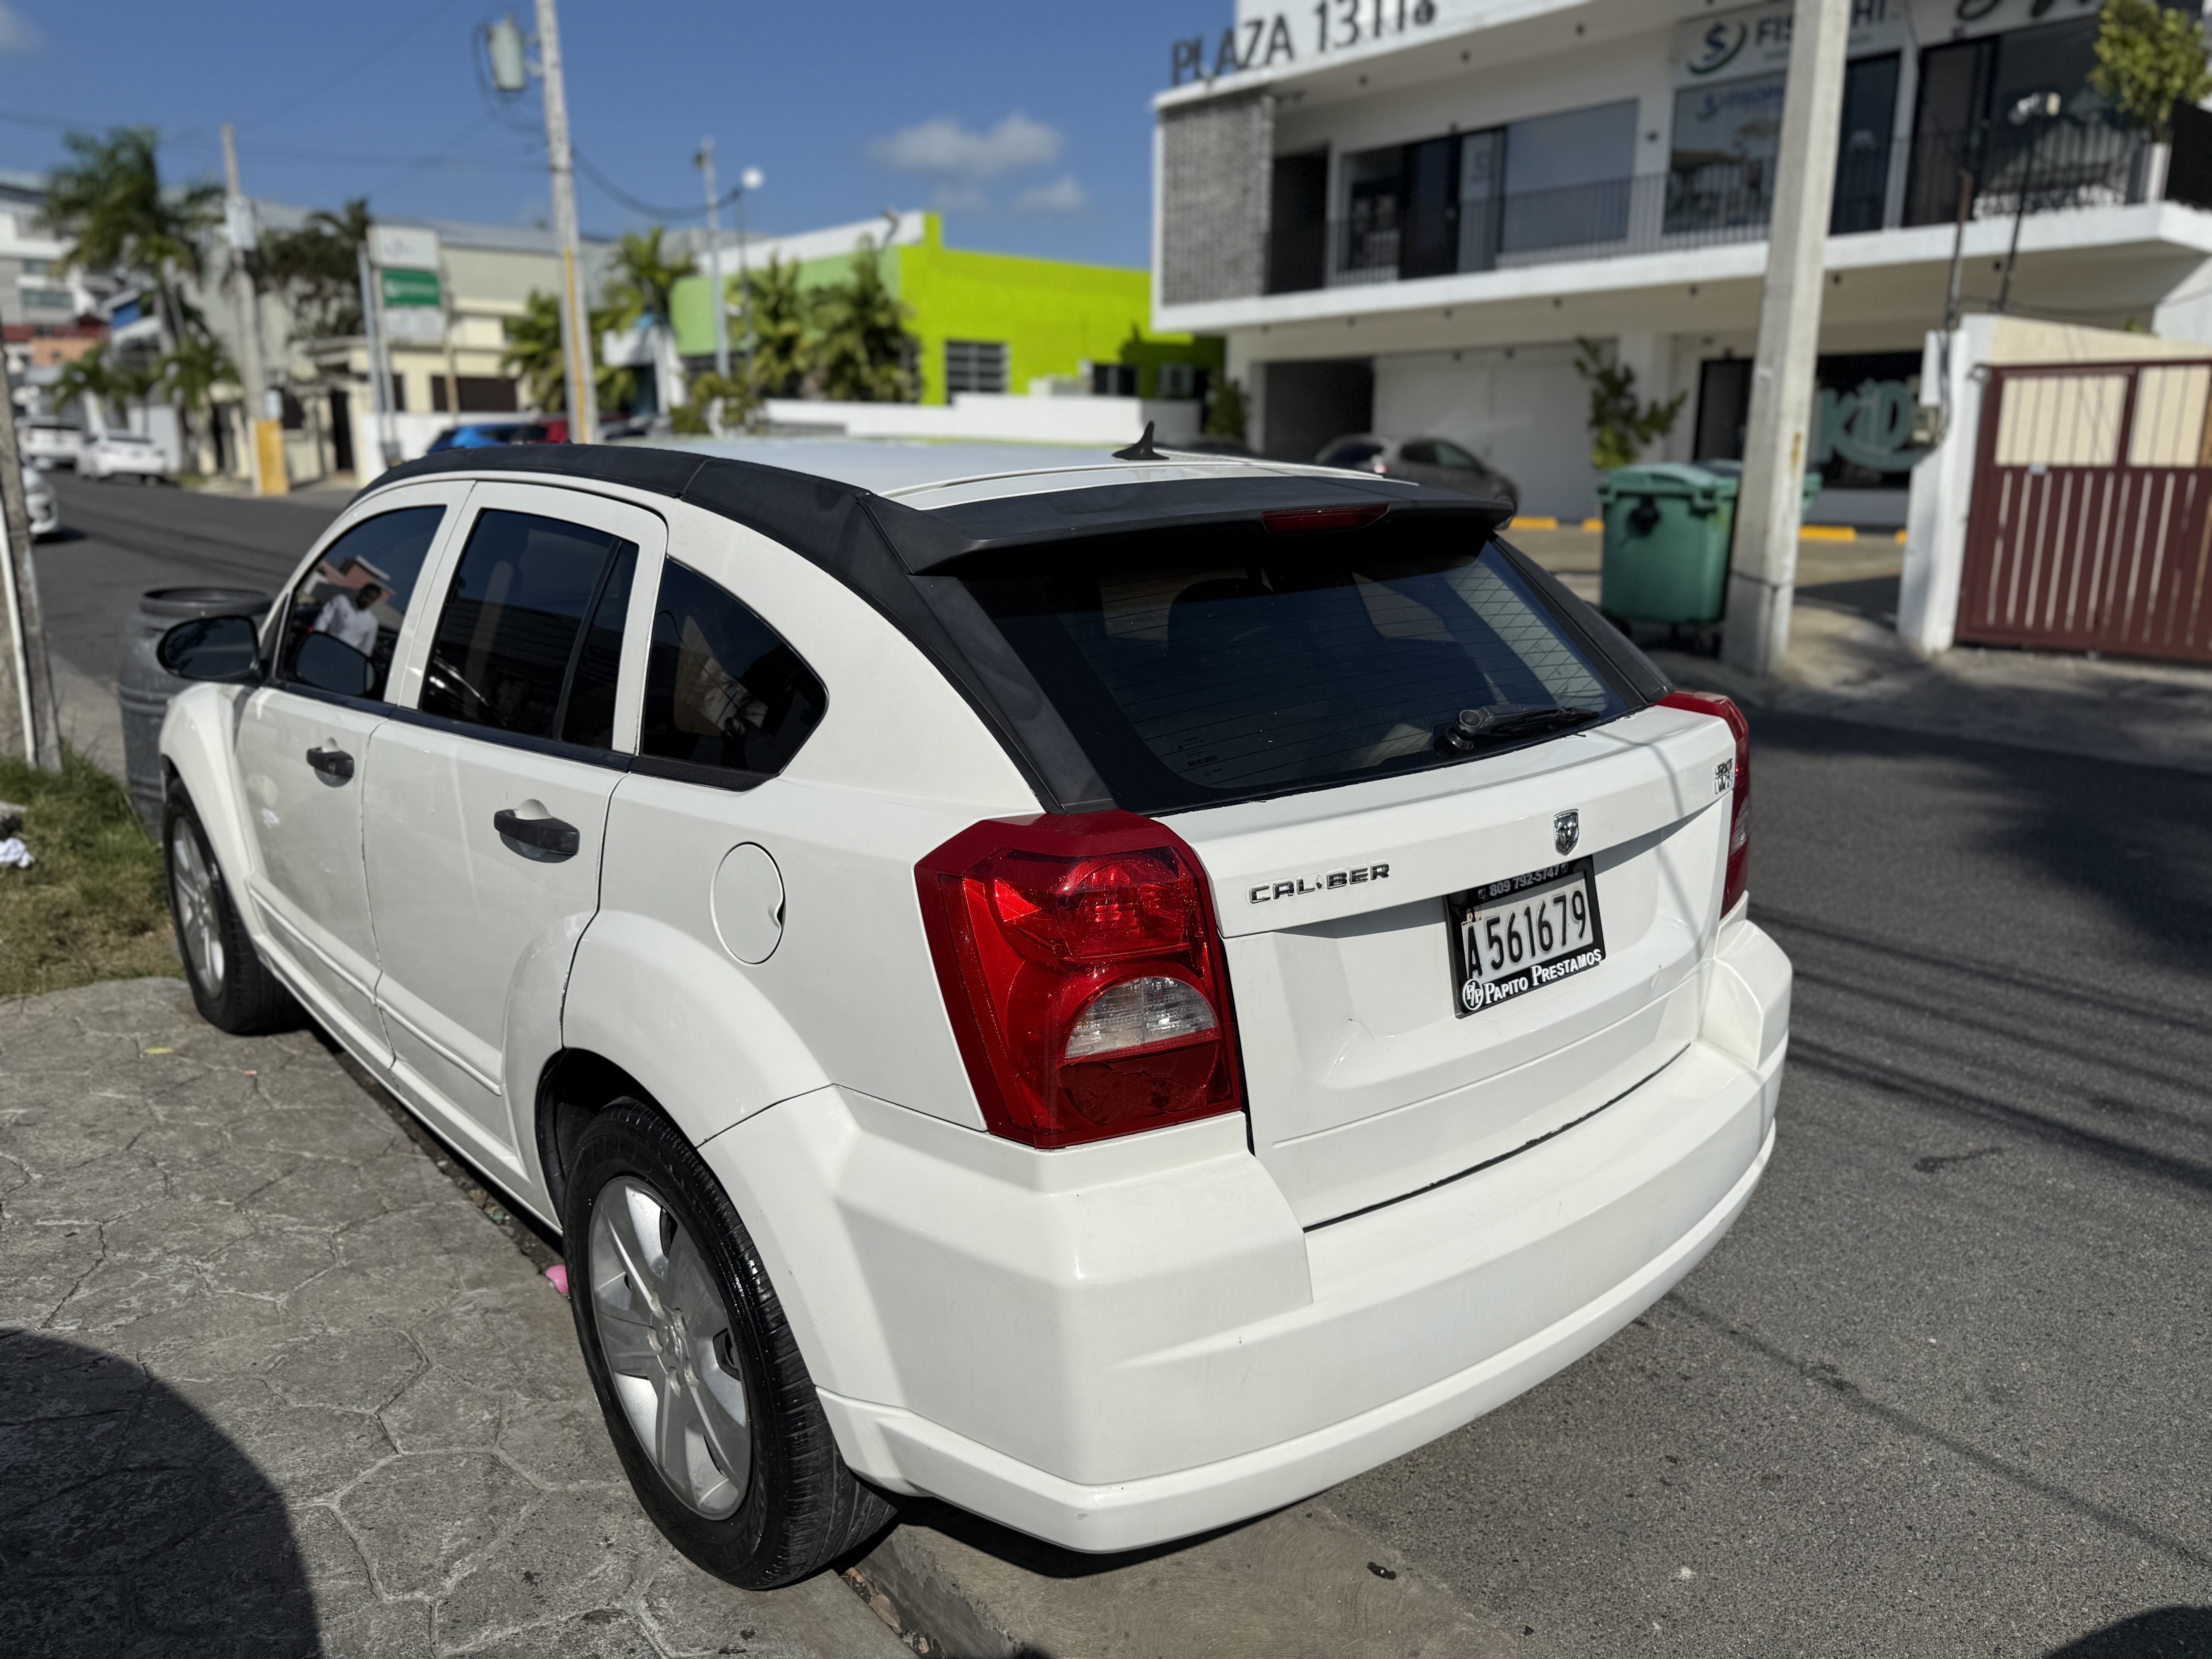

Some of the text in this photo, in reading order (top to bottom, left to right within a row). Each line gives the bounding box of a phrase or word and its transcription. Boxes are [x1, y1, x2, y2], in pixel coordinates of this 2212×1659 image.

[1171, 13, 1294, 86] PLAZA
[1489, 866, 1560, 896] 809 792-5747
[1467, 890, 1586, 979] A561679
[1484, 977, 1528, 1004] PAPITO
[1531, 949, 1602, 986] PRESTAMOS
